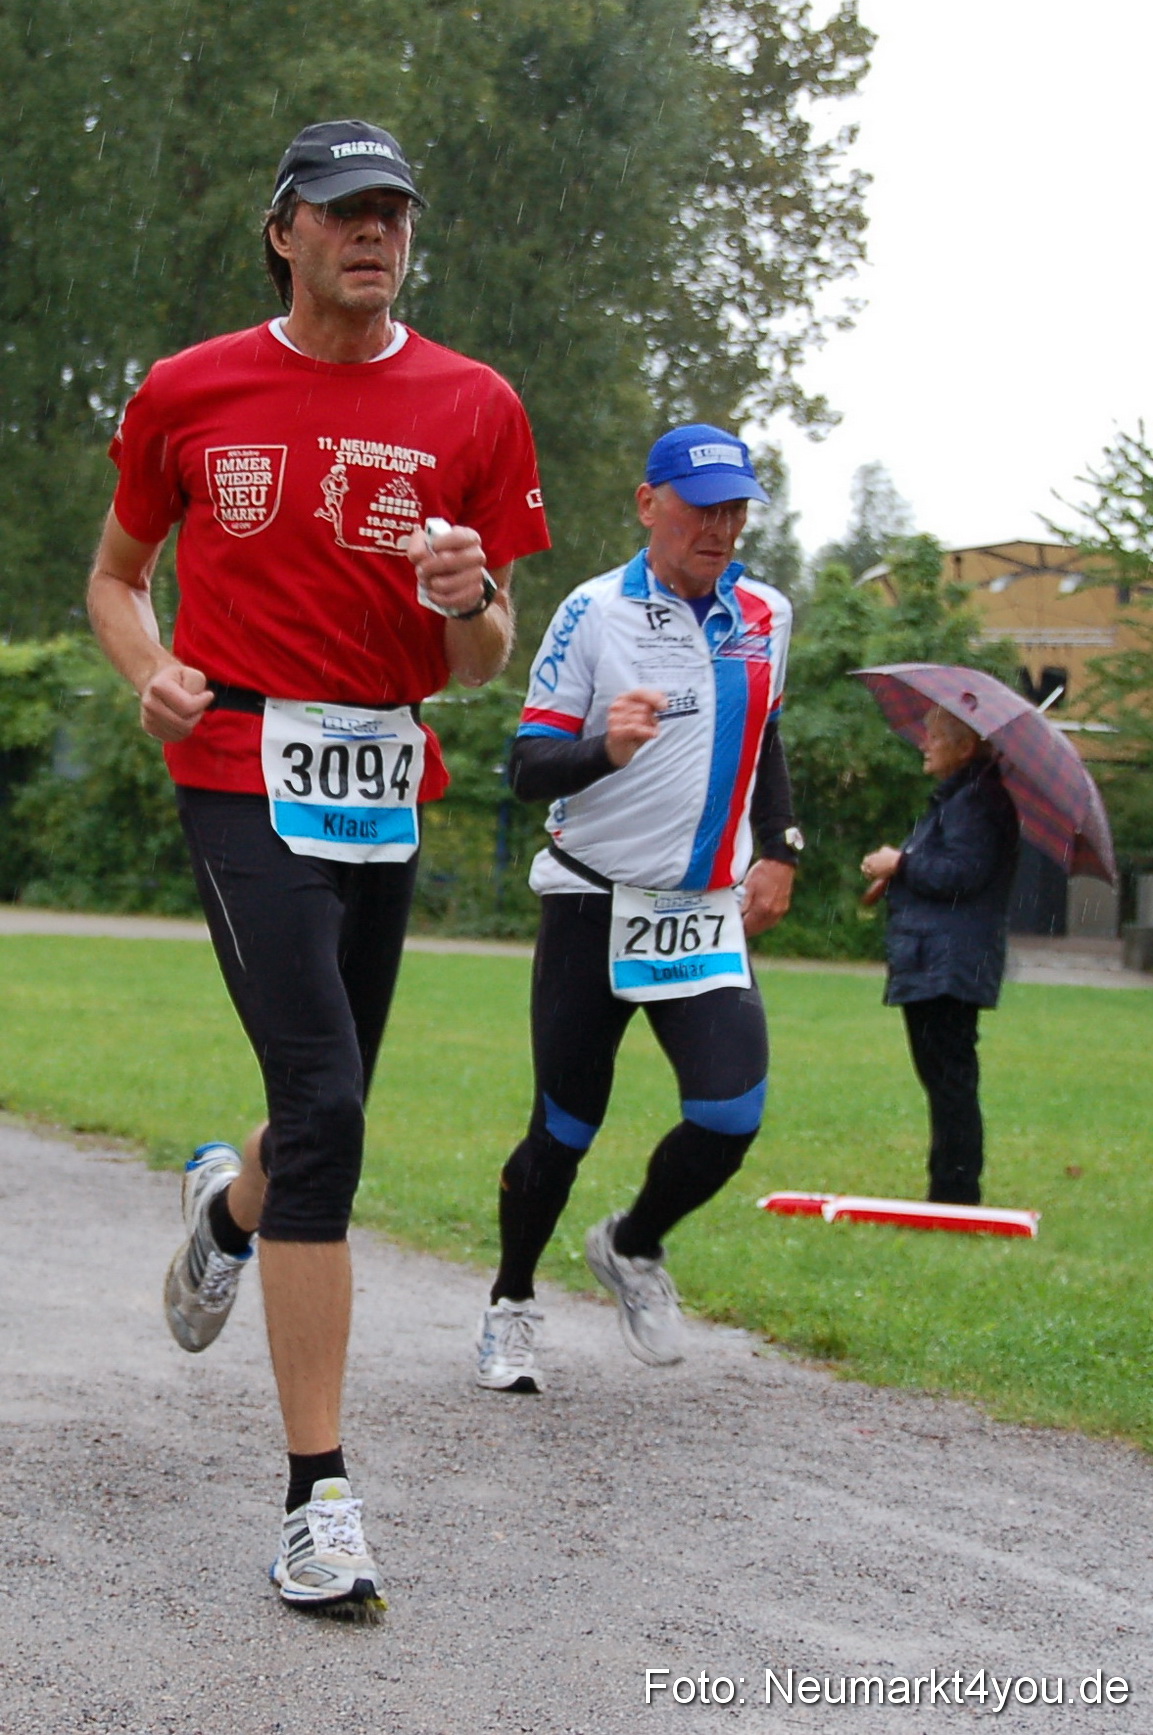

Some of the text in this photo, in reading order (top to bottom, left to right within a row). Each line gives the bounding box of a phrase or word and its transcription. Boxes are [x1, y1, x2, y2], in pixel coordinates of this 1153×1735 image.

[330, 141, 394, 160] TRISTAR
[317, 437, 437, 469] 11. NEUMARKTER
[335, 450, 418, 475] STADTLAUF
[216, 457, 271, 472] IMMER
[214, 471, 273, 487] WIEDER
[218, 486, 268, 507] NEU
[220, 507, 267, 521] MARKT
[282, 742, 413, 801] 3094
[323, 812, 378, 838] Klaus
[624, 914, 724, 956] 2067
[651, 963, 706, 982] Lothar
